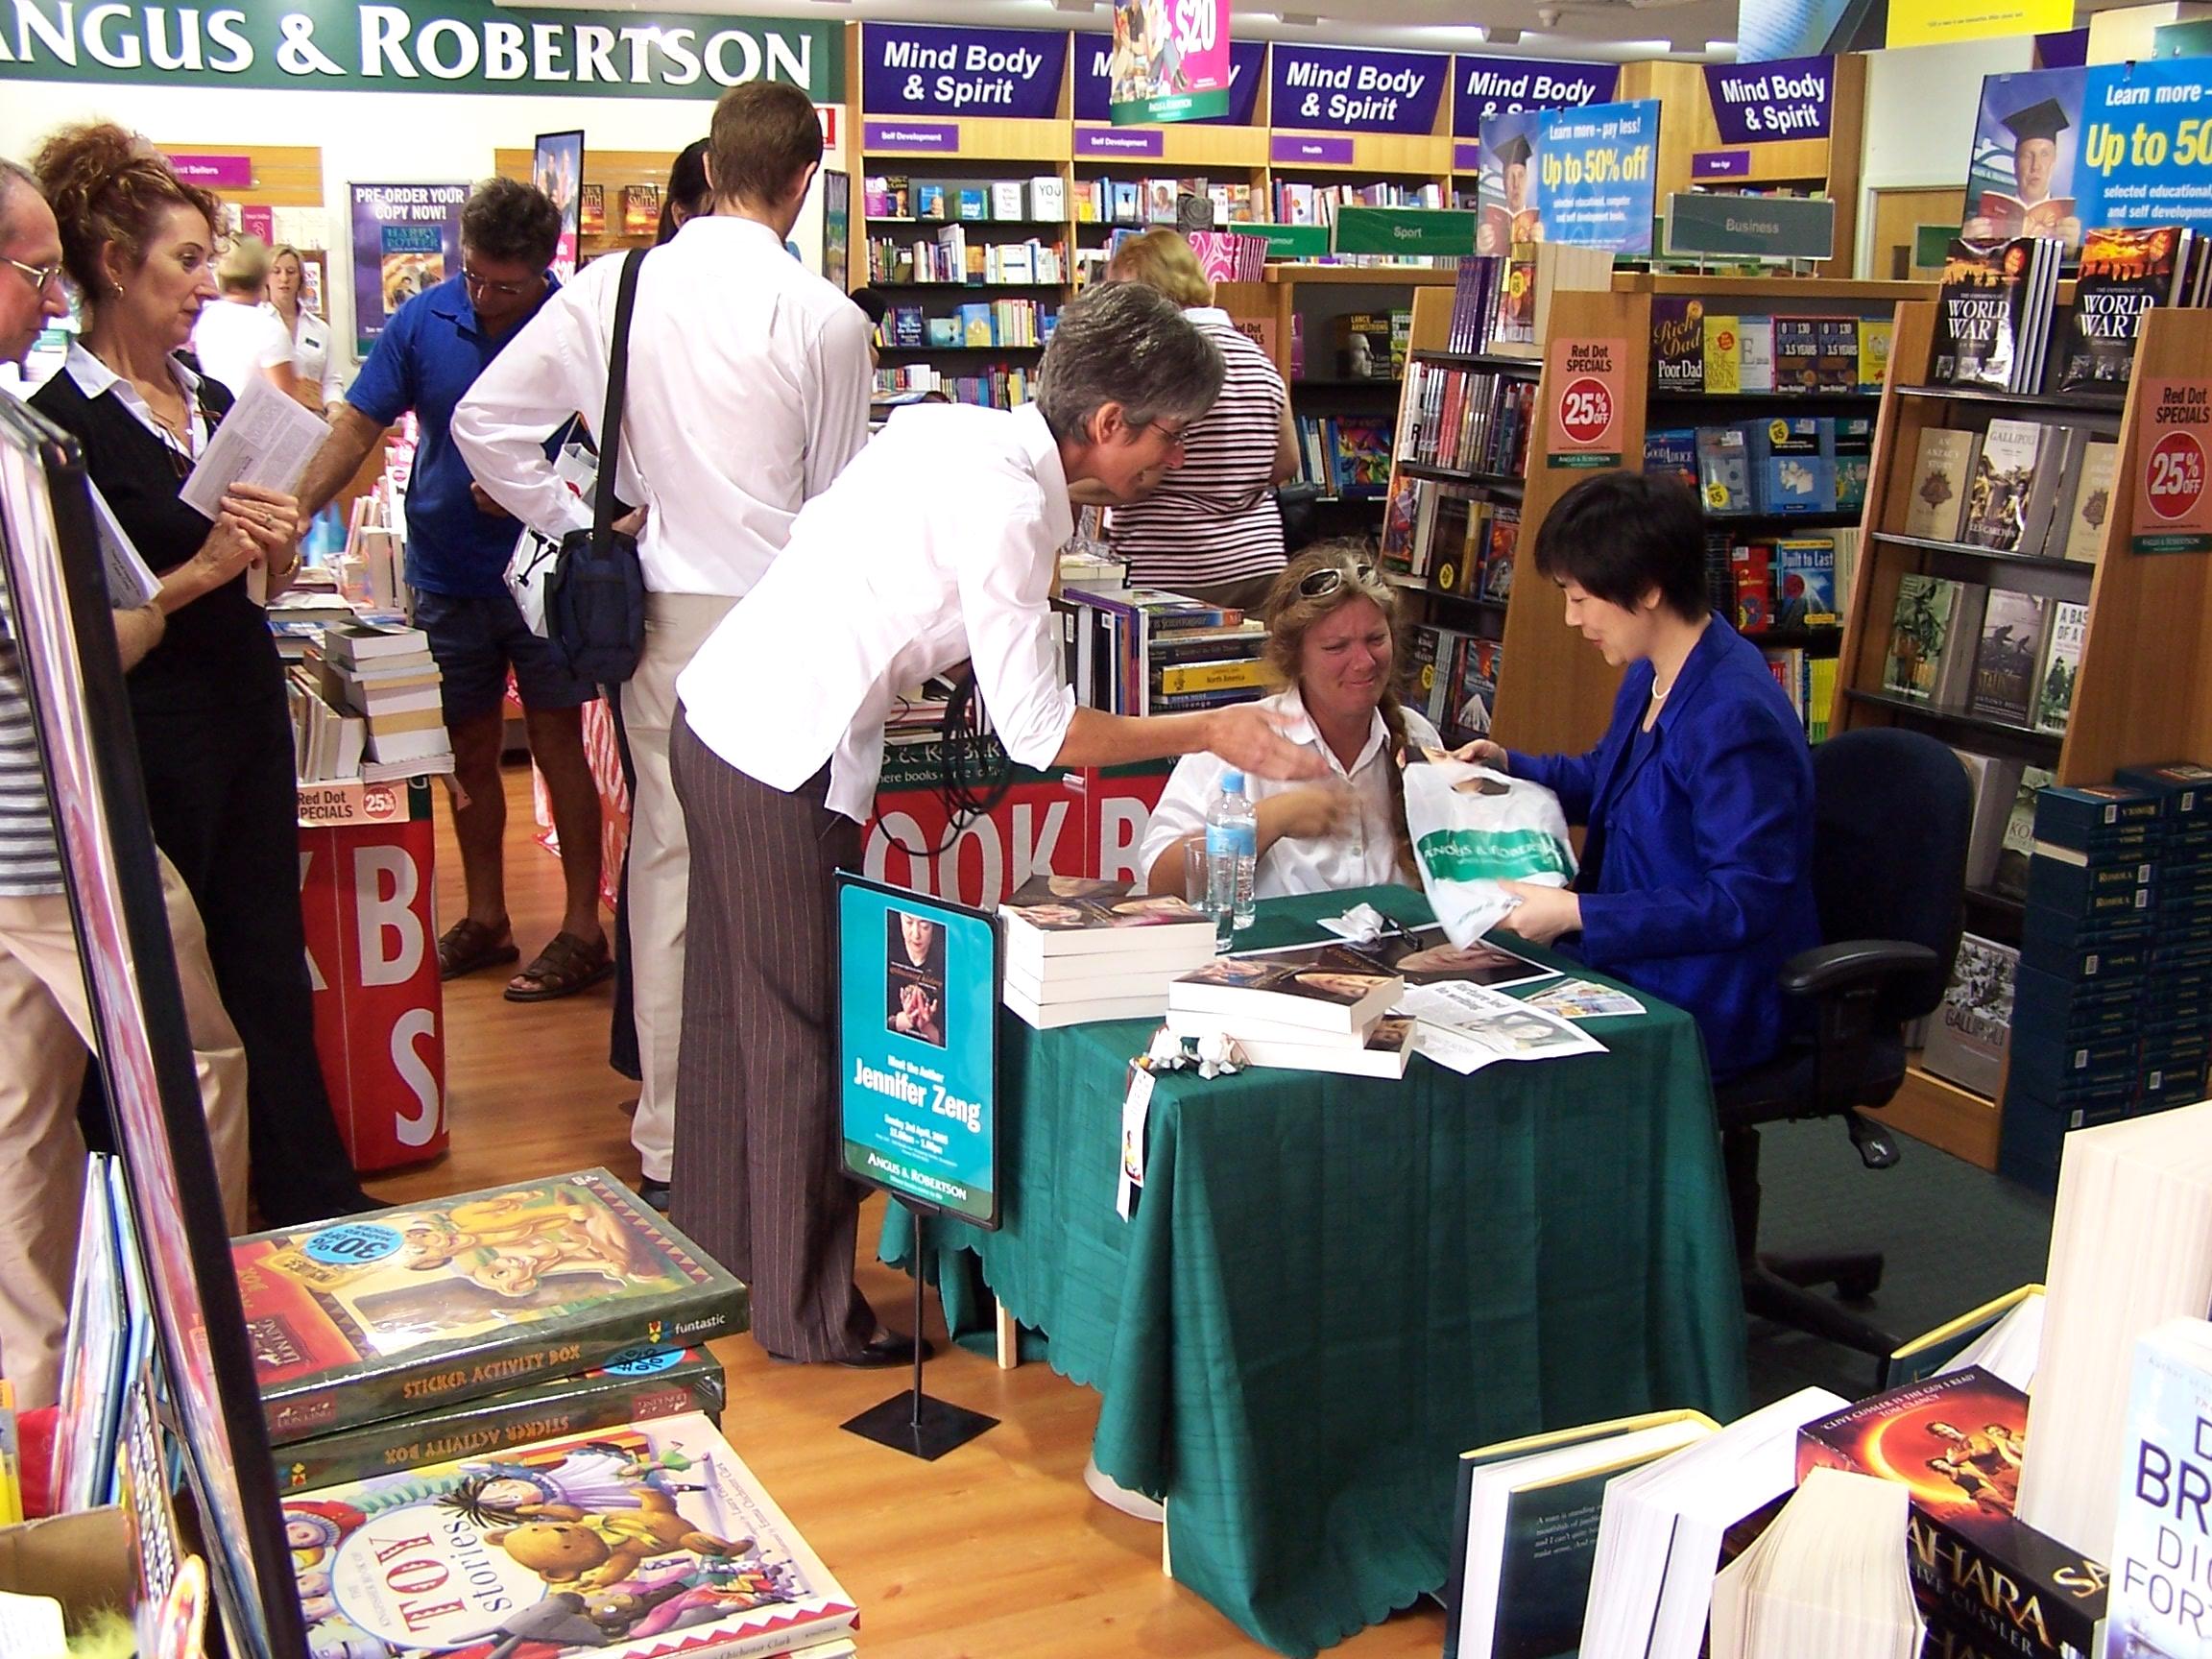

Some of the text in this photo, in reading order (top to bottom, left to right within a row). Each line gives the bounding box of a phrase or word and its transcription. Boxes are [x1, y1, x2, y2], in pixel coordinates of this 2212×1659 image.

[1174, 0, 1217, 60] $20
[276, 13, 348, 76] &
[360, 5, 811, 91] ROBERTSON
[883, 40, 1043, 79] Mind Body
[1286, 61, 1426, 98] Mind Body
[1467, 71, 1596, 107] Mind Body
[1720, 73, 1825, 103] Mind Body
[902, 74, 1014, 108] & Spirit
[2105, 84, 2201, 107] Learn more
[1300, 92, 1398, 124] & Spirit
[1550, 117, 1642, 140] Learn more pay less!
[1744, 104, 1820, 134] & Spirit
[881, 131, 942, 142] Self Development
[1091, 136, 1147, 148] Self Development
[1302, 145, 1323, 155] Health
[2085, 123, 2126, 177] Up
[2130, 122, 2168, 166] to
[1542, 145, 1650, 192] Up to 50% off
[355, 187, 464, 204] PRE-ORDER YOUR
[628, 195, 657, 206] SMITH
[2104, 184, 2148, 199] selected
[374, 205, 447, 220] COPY NOW!
[2107, 205, 2127, 218] and
[2128, 204, 2150, 218] self
[1394, 227, 1422, 240] Sport
[1726, 218, 1780, 233] Business
[1267, 237, 1294, 246] umour
[1948, 300, 2010, 319] WORLD
[2082, 295, 2154, 315] WORLD
[1247, 323, 1262, 333] Dot
[1652, 311, 1695, 343] Rich
[1948, 319, 1991, 340] WAR
[2080, 315, 2129, 337] WAR
[1572, 345, 1609, 358] Red Dot
[1664, 327, 1702, 359] Dad
[1797, 344, 1817, 356] YEARS
[1839, 344, 1858, 356] YEARS
[1566, 359, 1613, 373] SPECIALS
[1658, 360, 1703, 379] Poor Dad
[2162, 387, 2207, 404] Red Dot
[1565, 393, 1607, 424] 25%
[2155, 407, 2210, 424] SPECIALS
[1594, 413, 1609, 424] OFF
[2151, 452, 2199, 495] 25%
[2182, 478, 2201, 494] OFF
[1711, 492, 1724, 503] $5
[1814, 550, 1834, 566] Last
[2058, 608, 2068, 618] A
[2056, 626, 2079, 641] OF A
[904, 770, 938, 782] books
[298, 790, 347, 805] Red Dot
[300, 805, 353, 820] PECIALS
[864, 801, 1070, 911] OOK
[854, 1057, 981, 1134] Jennifer Zeng
[867, 1152, 901, 1175] ANGUS
[911, 1168, 967, 1201] ROBERTSON
[675, 1313, 726, 1334] funtastic
[403, 1344, 581, 1398] STICKER ACTIVITY BOX
[1853, 1400, 1892, 1418] CUSSLER
[385, 1416, 569, 1464] STICKER ACTIVITY BOX
[444, 1520, 513, 1613] stories
[369, 1532, 468, 1632] TOY
[1907, 1515, 2056, 1649] AHARA
[1952, 1591, 2033, 1657] CUSSLER
